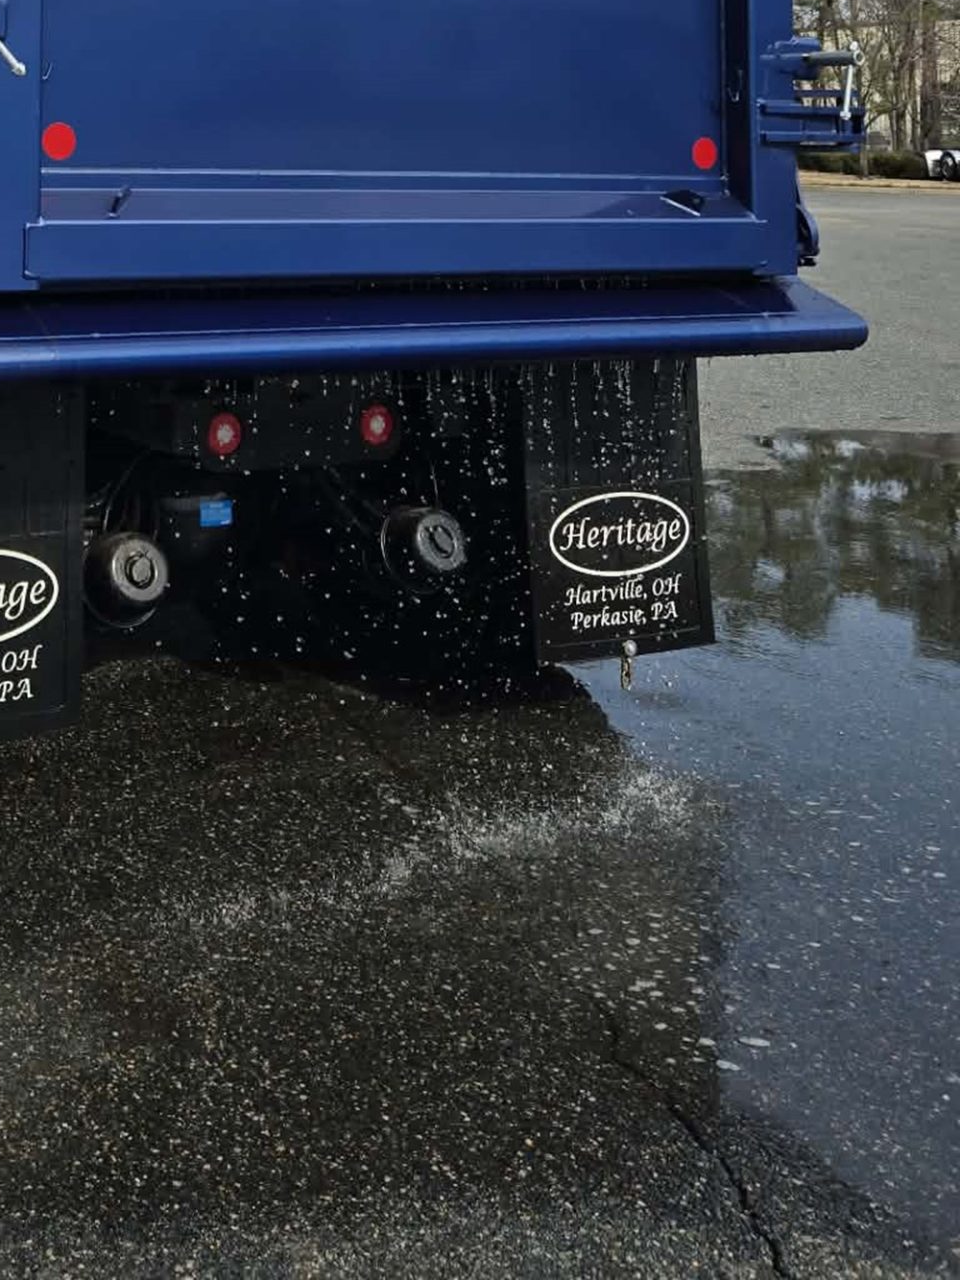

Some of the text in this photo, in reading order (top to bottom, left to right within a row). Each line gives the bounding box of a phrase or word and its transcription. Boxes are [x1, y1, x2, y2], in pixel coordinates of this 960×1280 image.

[559, 518, 681, 552] Heritage
[564, 573, 682, 606] Hartville, OH
[571, 600, 679, 630] Perkasie, PA
[1, 645, 43, 672] OH
